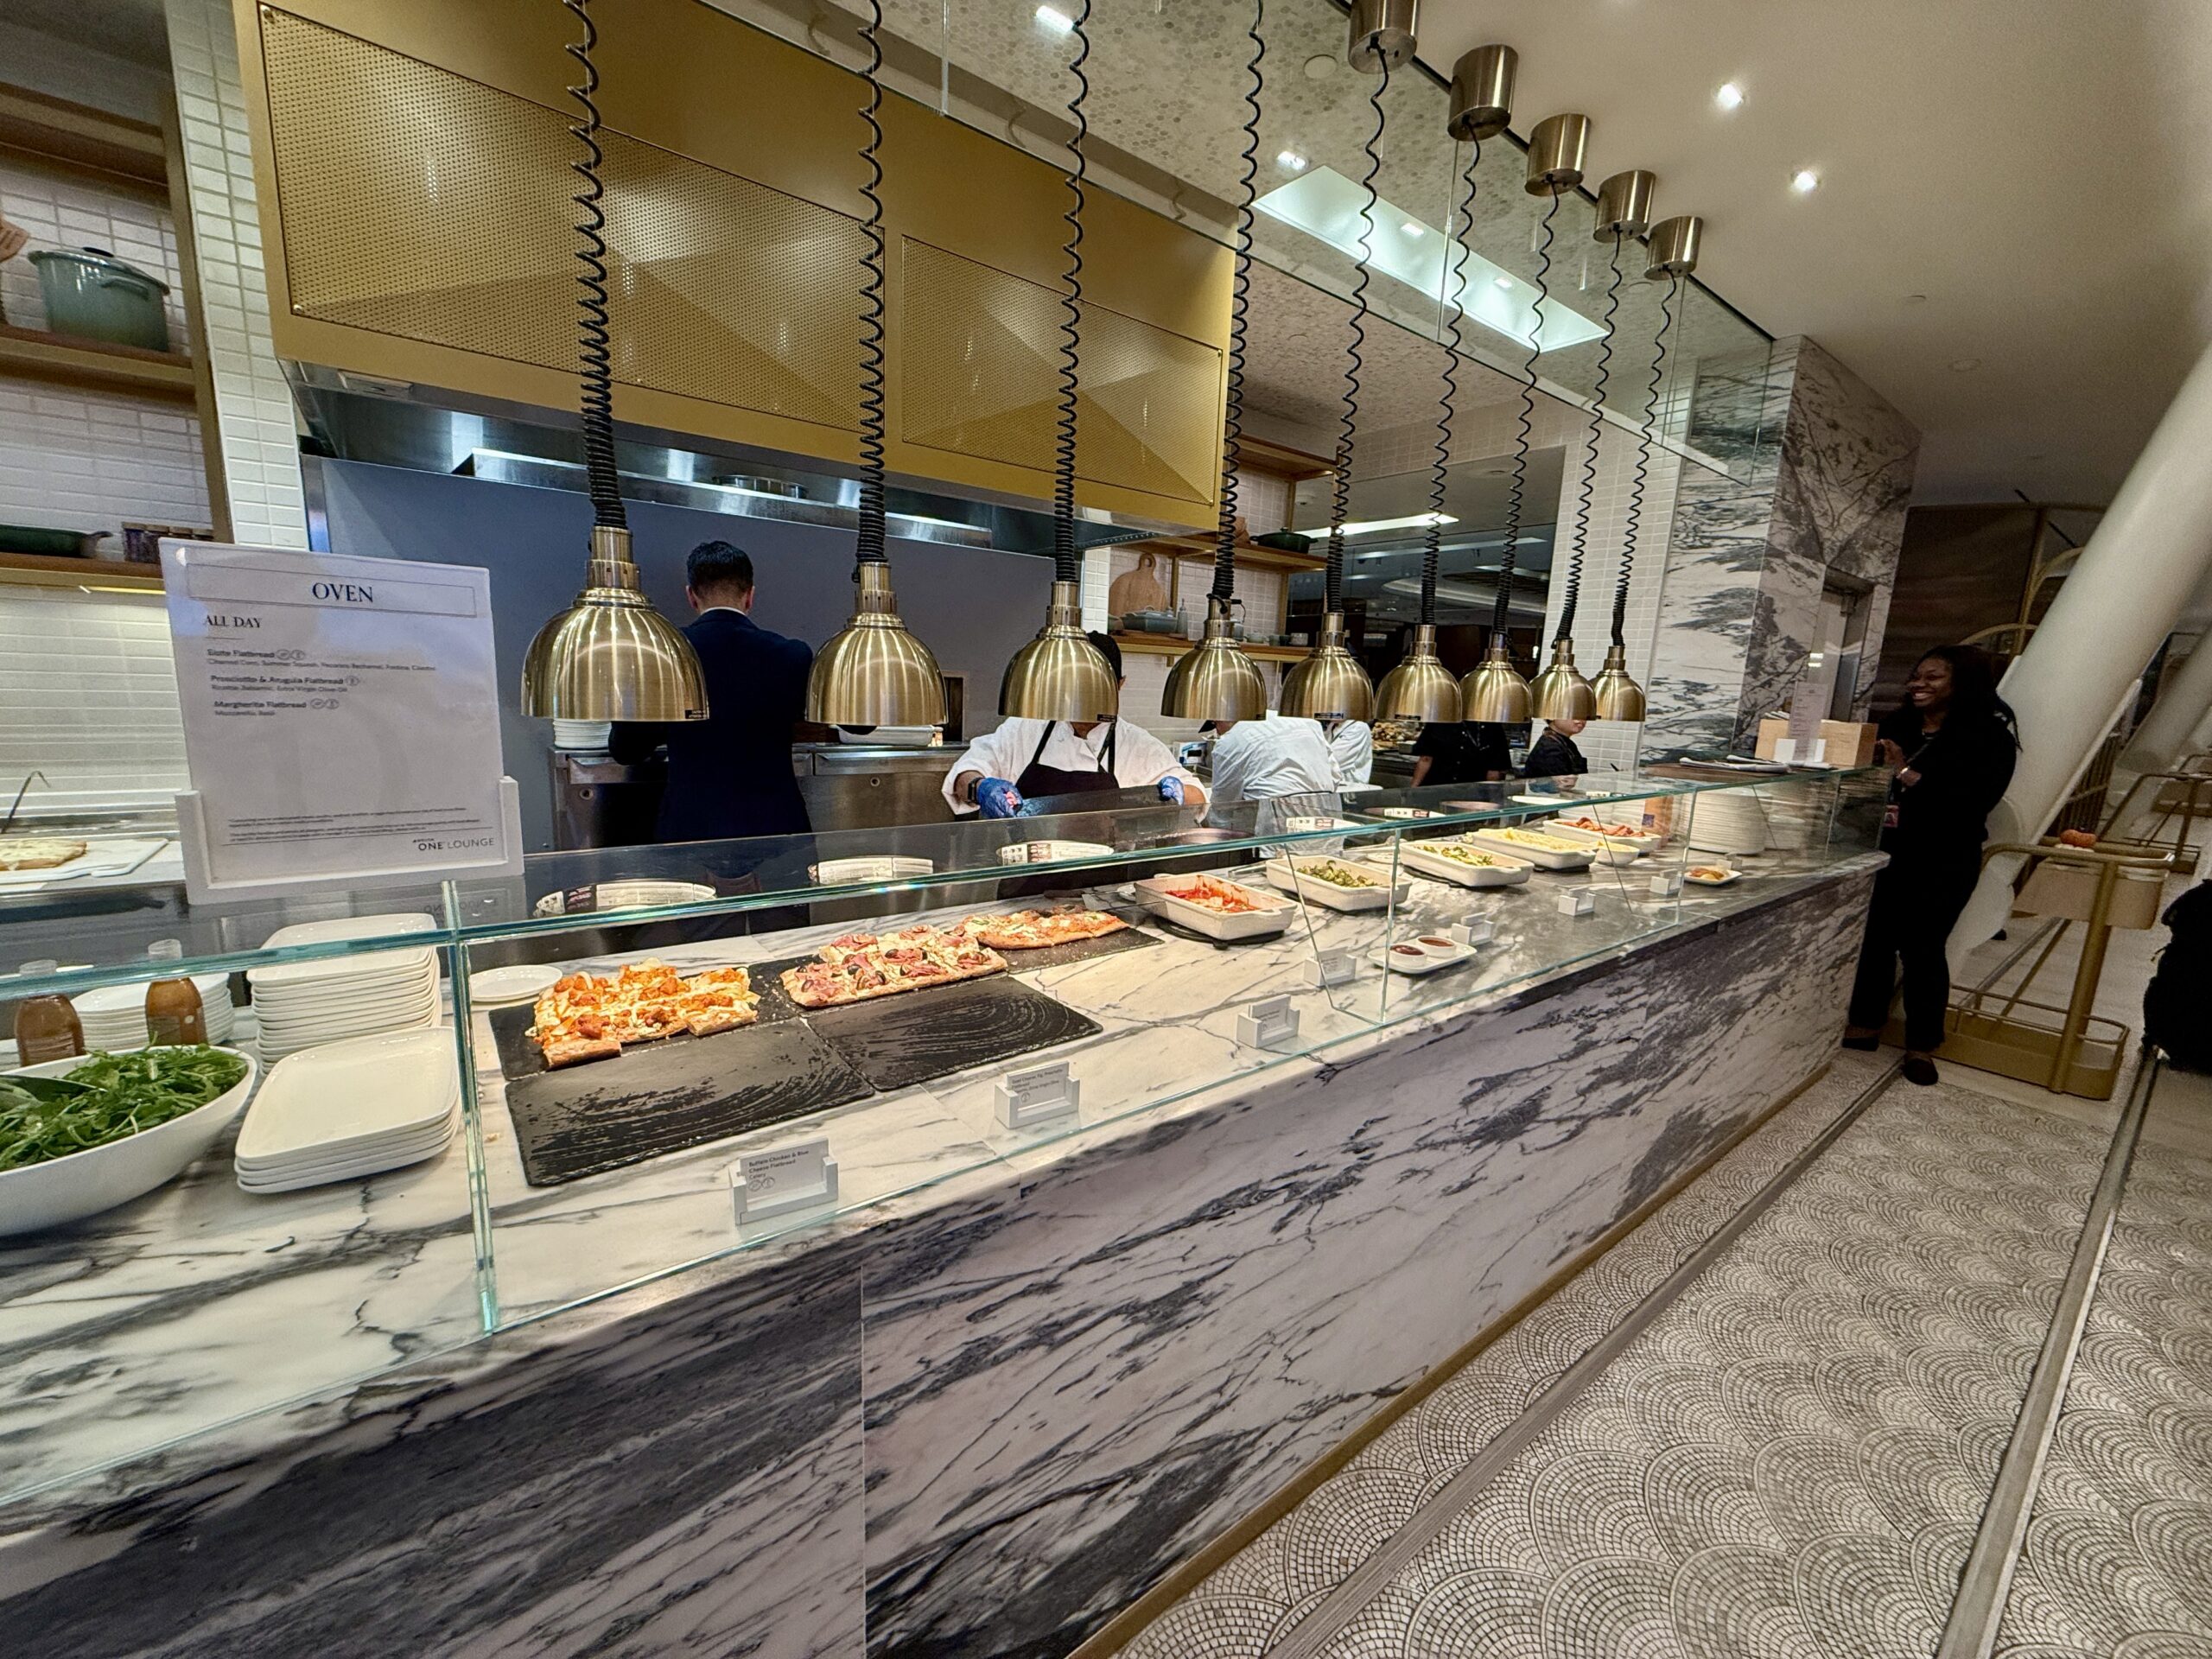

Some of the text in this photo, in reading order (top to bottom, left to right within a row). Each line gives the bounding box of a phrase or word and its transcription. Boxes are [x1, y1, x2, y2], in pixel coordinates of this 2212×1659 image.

[312, 582, 373, 604] OVEN
[204, 614, 263, 630] ALL DAY
[232, 650, 275, 658] Flatbread
[266, 701, 307, 709] Flatbread
[417, 837, 495, 851] ONE LOUNGE
[769, 1154, 791, 1162] Chicken
[770, 1159, 796, 1168] Flatbread
